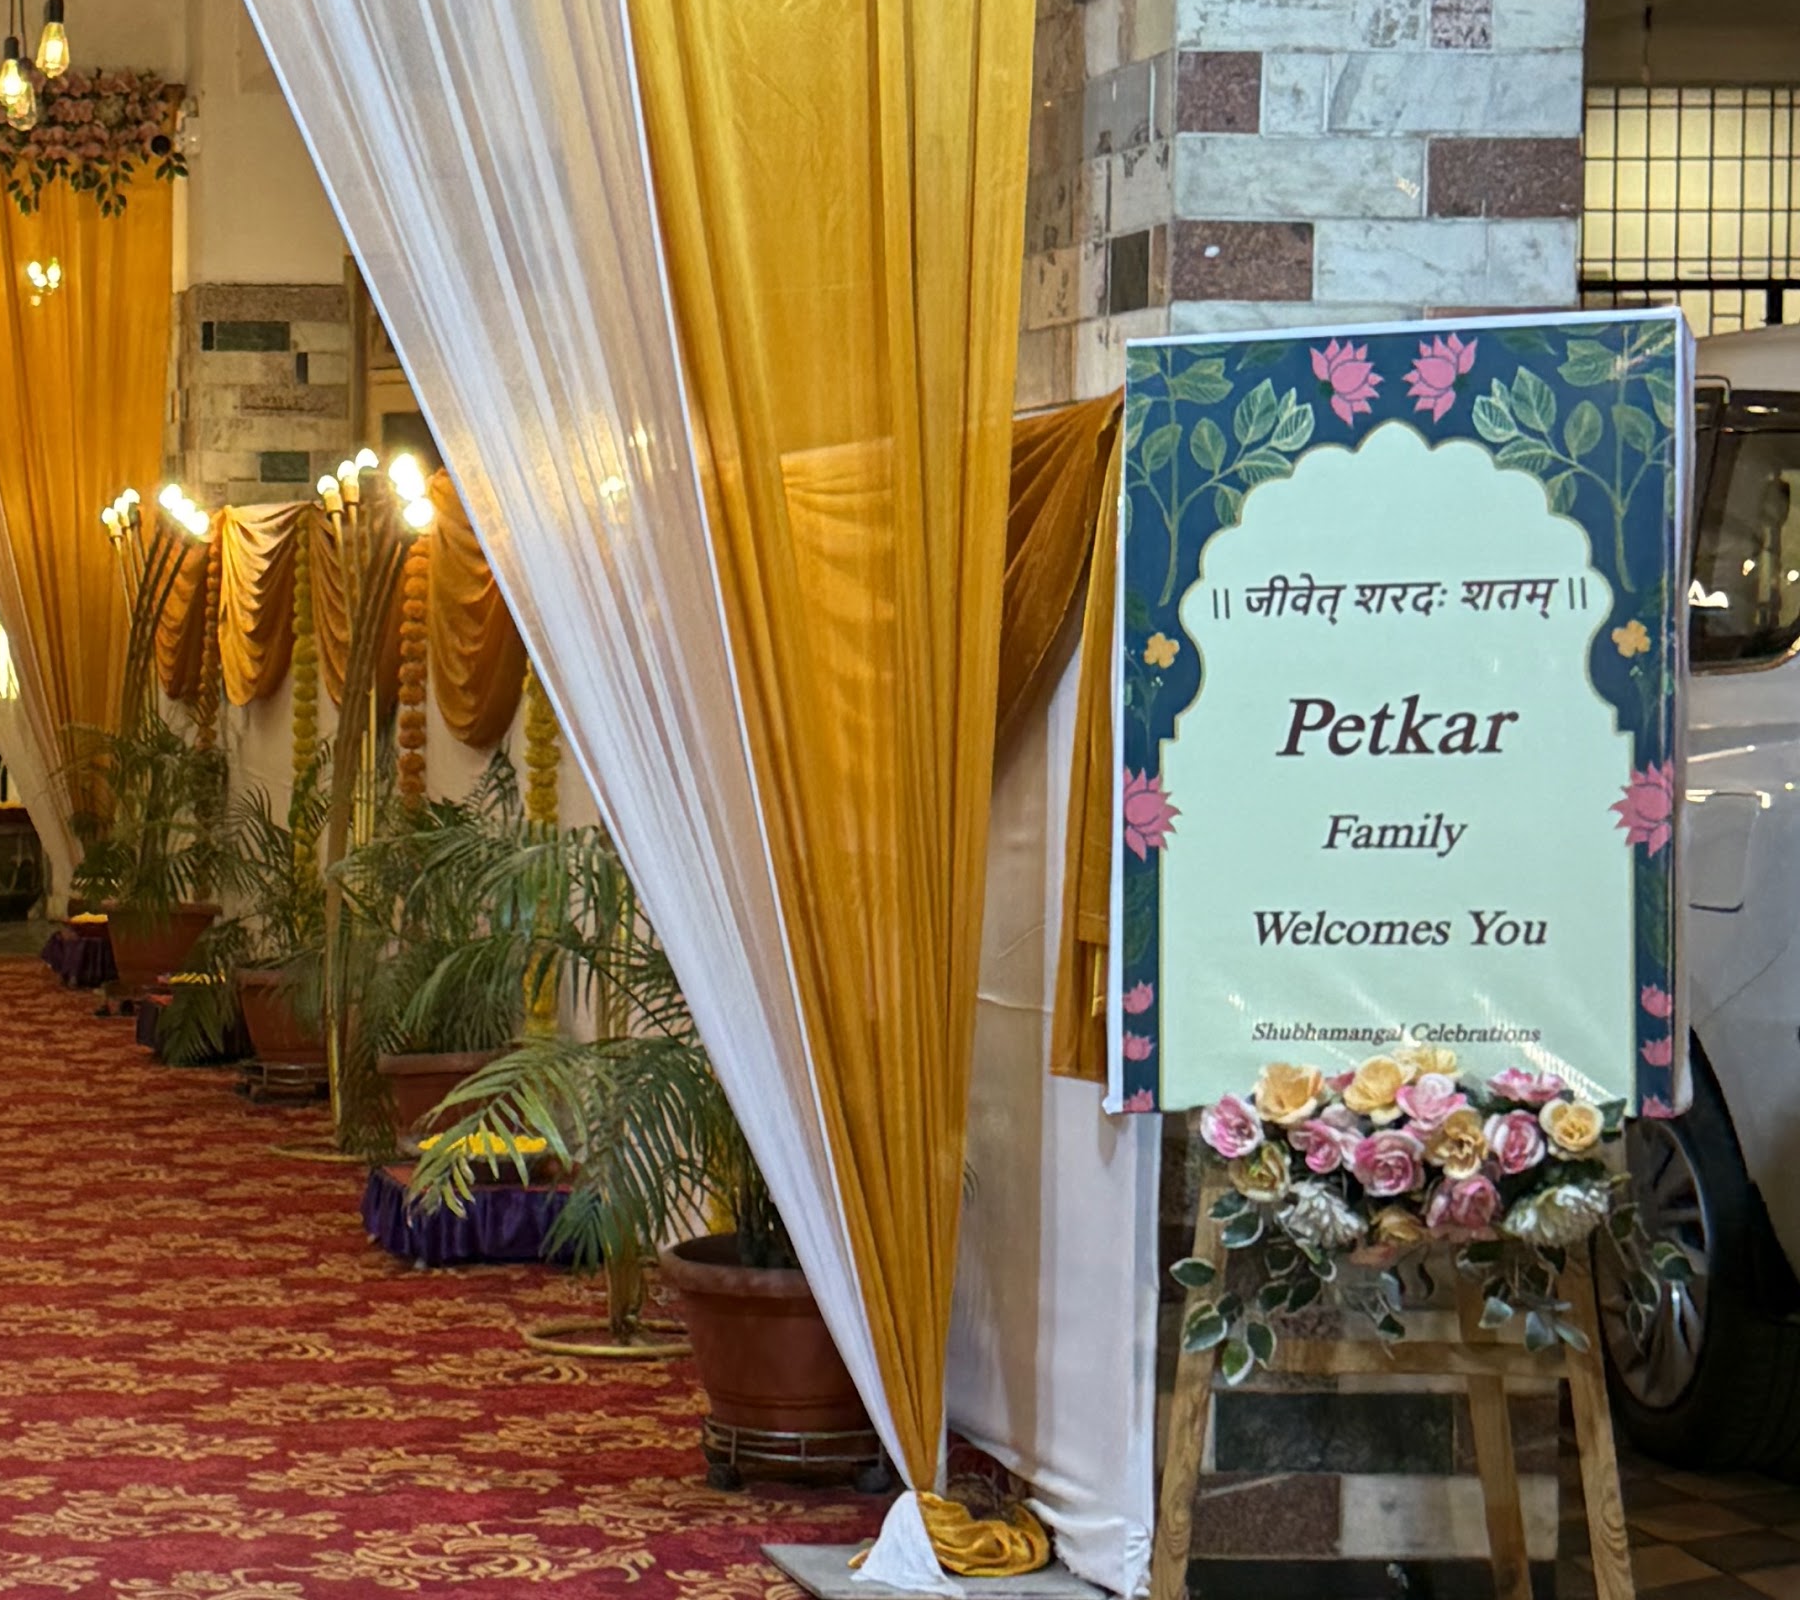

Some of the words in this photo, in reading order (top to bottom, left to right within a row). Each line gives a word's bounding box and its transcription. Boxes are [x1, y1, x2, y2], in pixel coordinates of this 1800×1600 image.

[1245, 573, 1347, 626] जीवेत्
[1354, 581, 1448, 616] शरदः
[1460, 578, 1559, 619] शतम्
[1275, 693, 1520, 757] Petkar
[1321, 812, 1468, 858] Family
[1253, 910, 1452, 946] Welcomes
[1468, 910, 1549, 946] You
[1252, 1022, 1406, 1046] Shubhamangal
[1410, 1022, 1542, 1043] Celebrations
